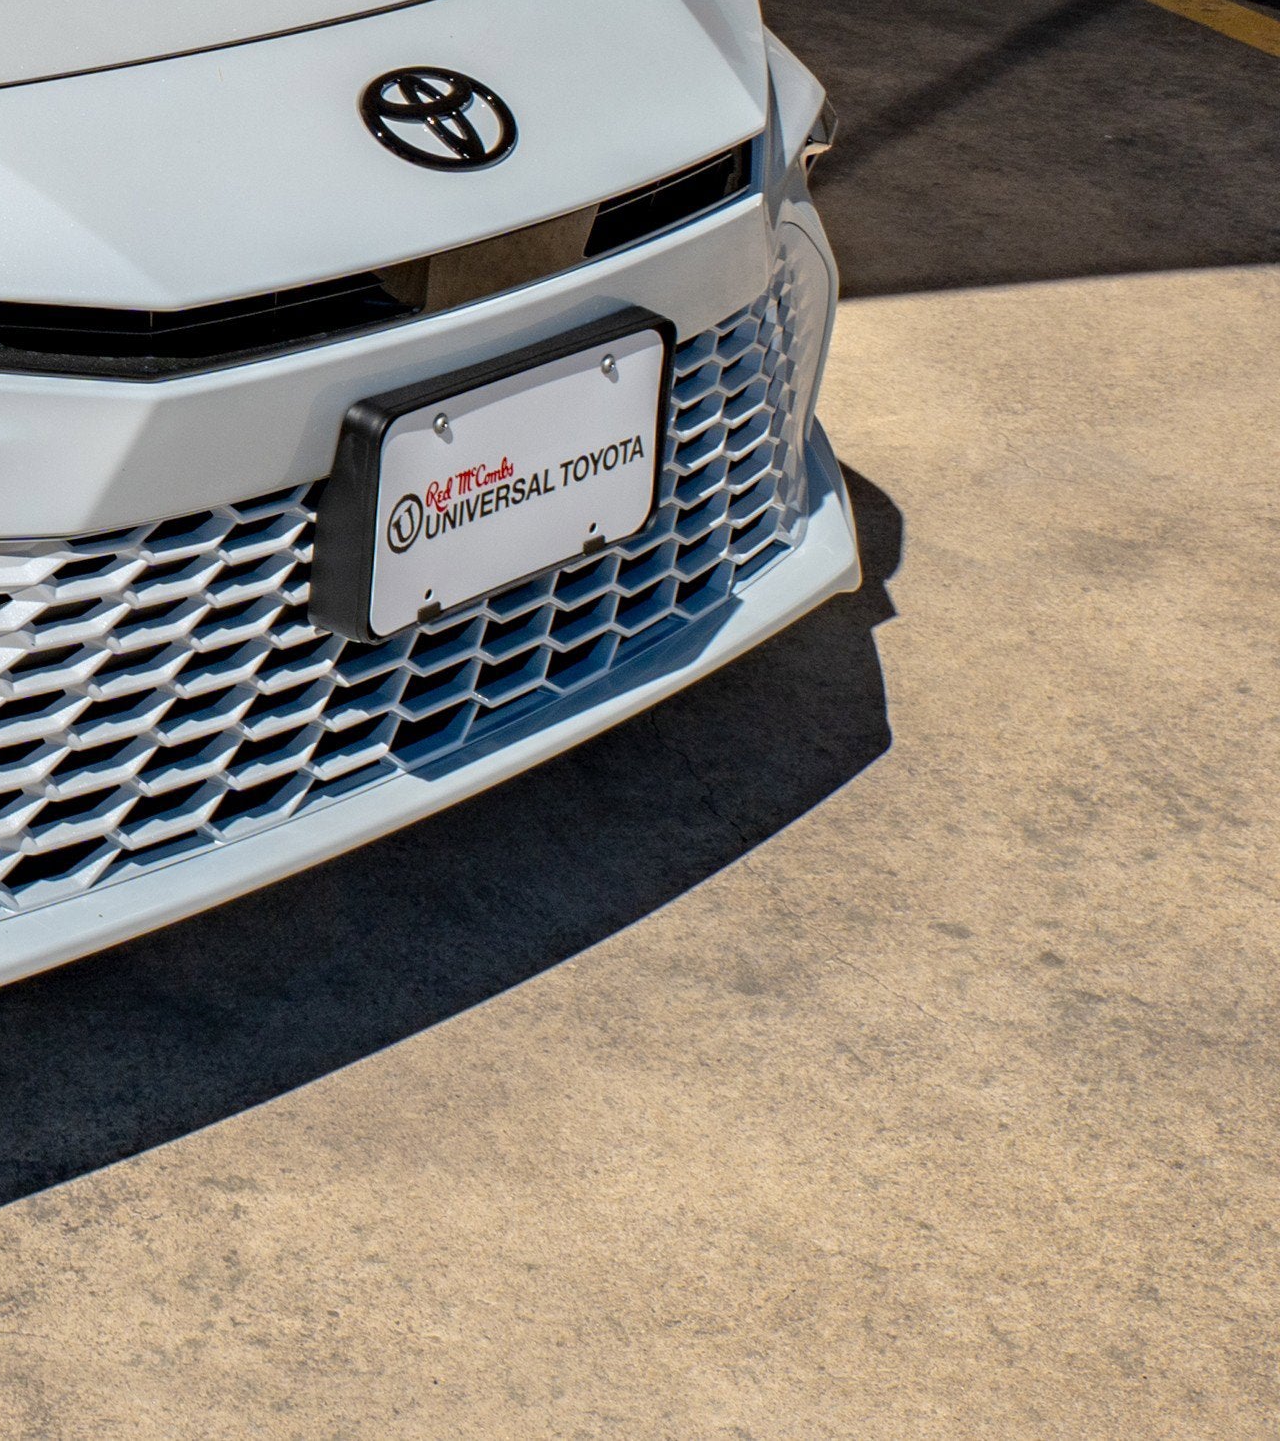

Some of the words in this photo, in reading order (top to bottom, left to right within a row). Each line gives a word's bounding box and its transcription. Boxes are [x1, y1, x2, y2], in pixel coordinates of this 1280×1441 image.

[425, 468, 556, 540] UNIVERSAL
[559, 434, 645, 487] TOYOTA
[426, 474, 453, 513] Red
